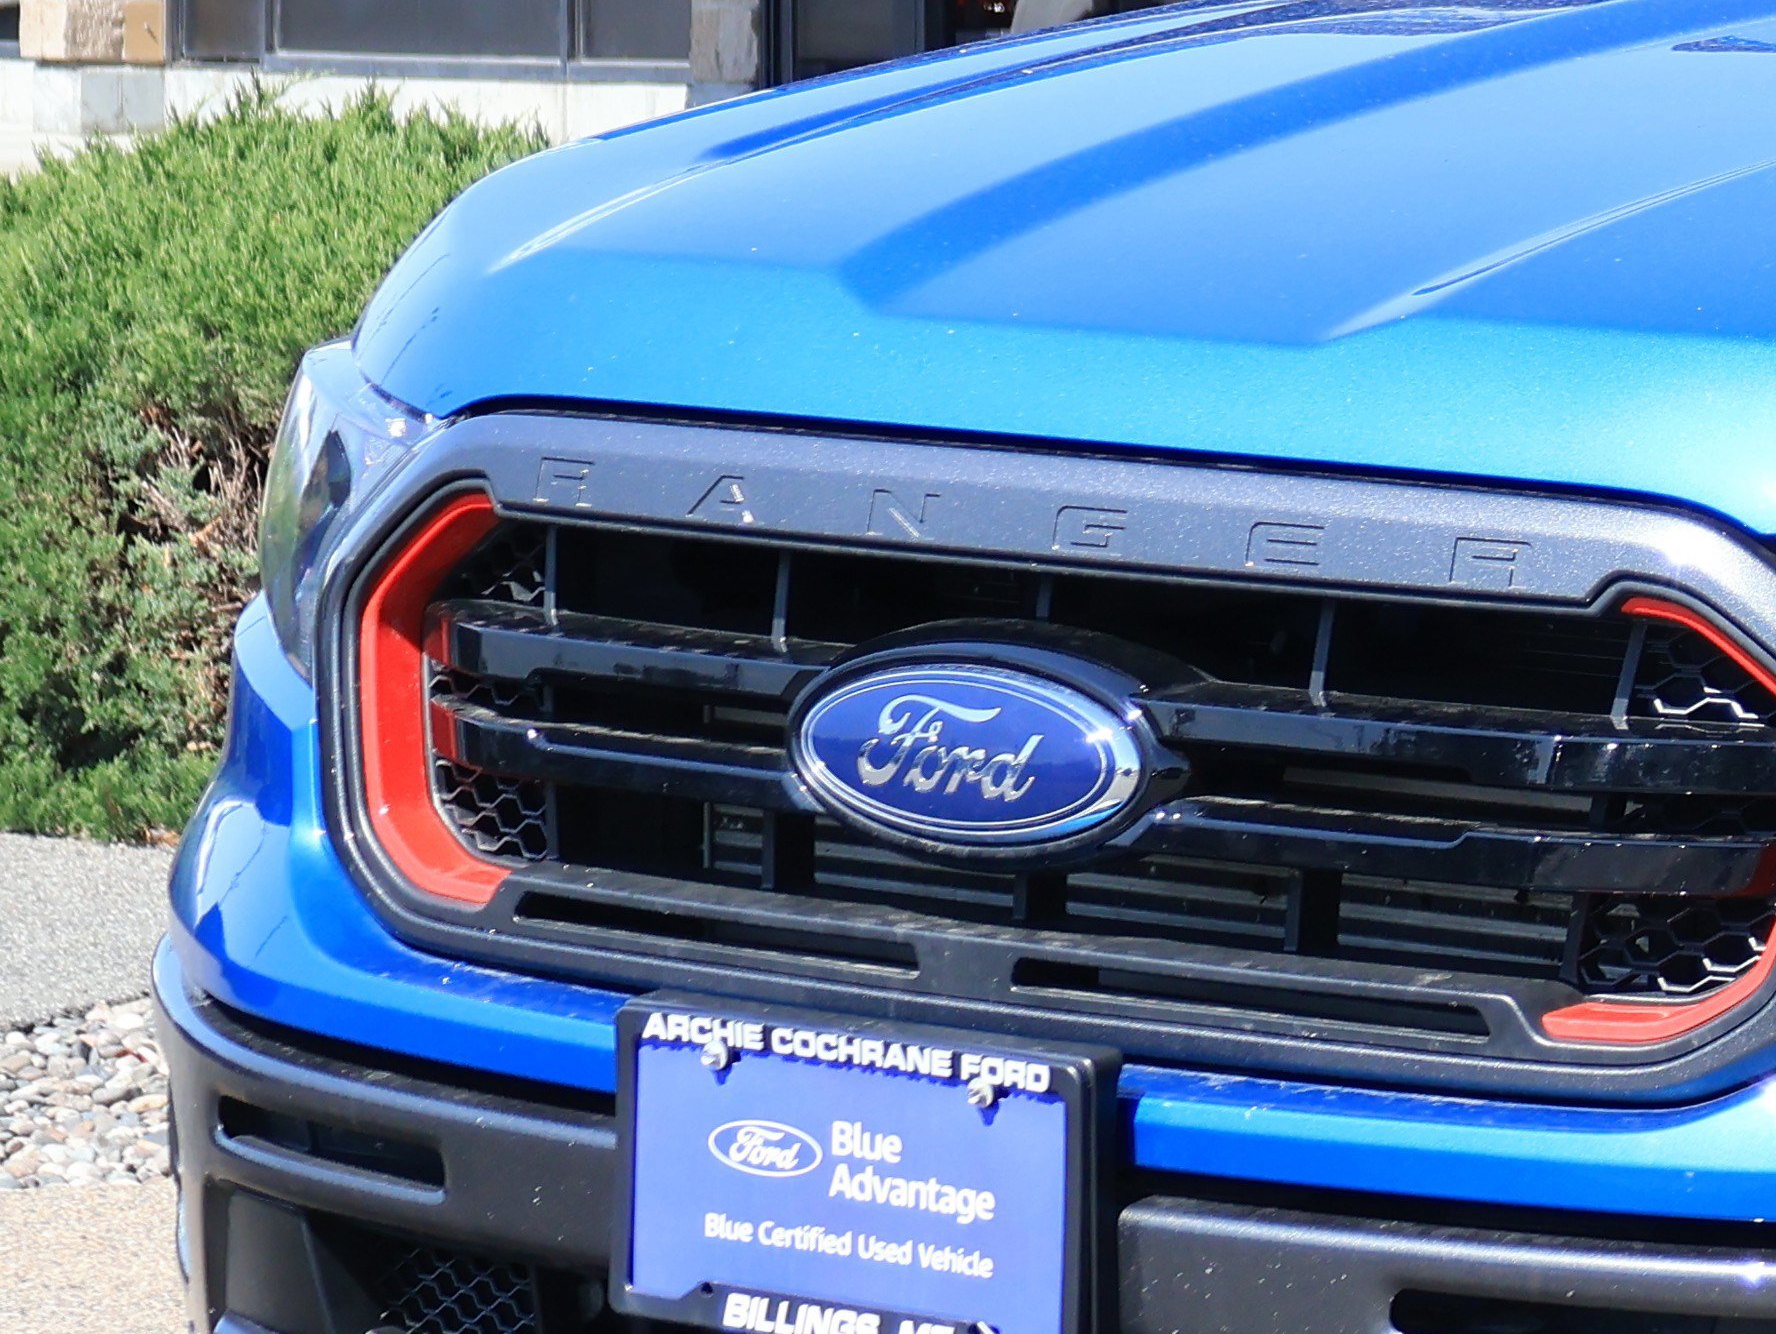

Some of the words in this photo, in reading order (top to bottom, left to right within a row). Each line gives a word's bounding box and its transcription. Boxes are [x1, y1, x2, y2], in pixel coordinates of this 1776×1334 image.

[534, 455, 1533, 588] RANGER
[857, 694, 1044, 802] Ford
[642, 1013, 764, 1049] ARCHIE
[771, 1027, 953, 1078] COCHRANE
[961, 1054, 1051, 1092] FORD
[831, 1120, 902, 1163] Blue
[829, 1164, 996, 1223] Advantage
[704, 1212, 753, 1243] Blue
[758, 1220, 852, 1256] Certified
[858, 1234, 913, 1266] Used
[918, 1243, 994, 1278] Vehicle
